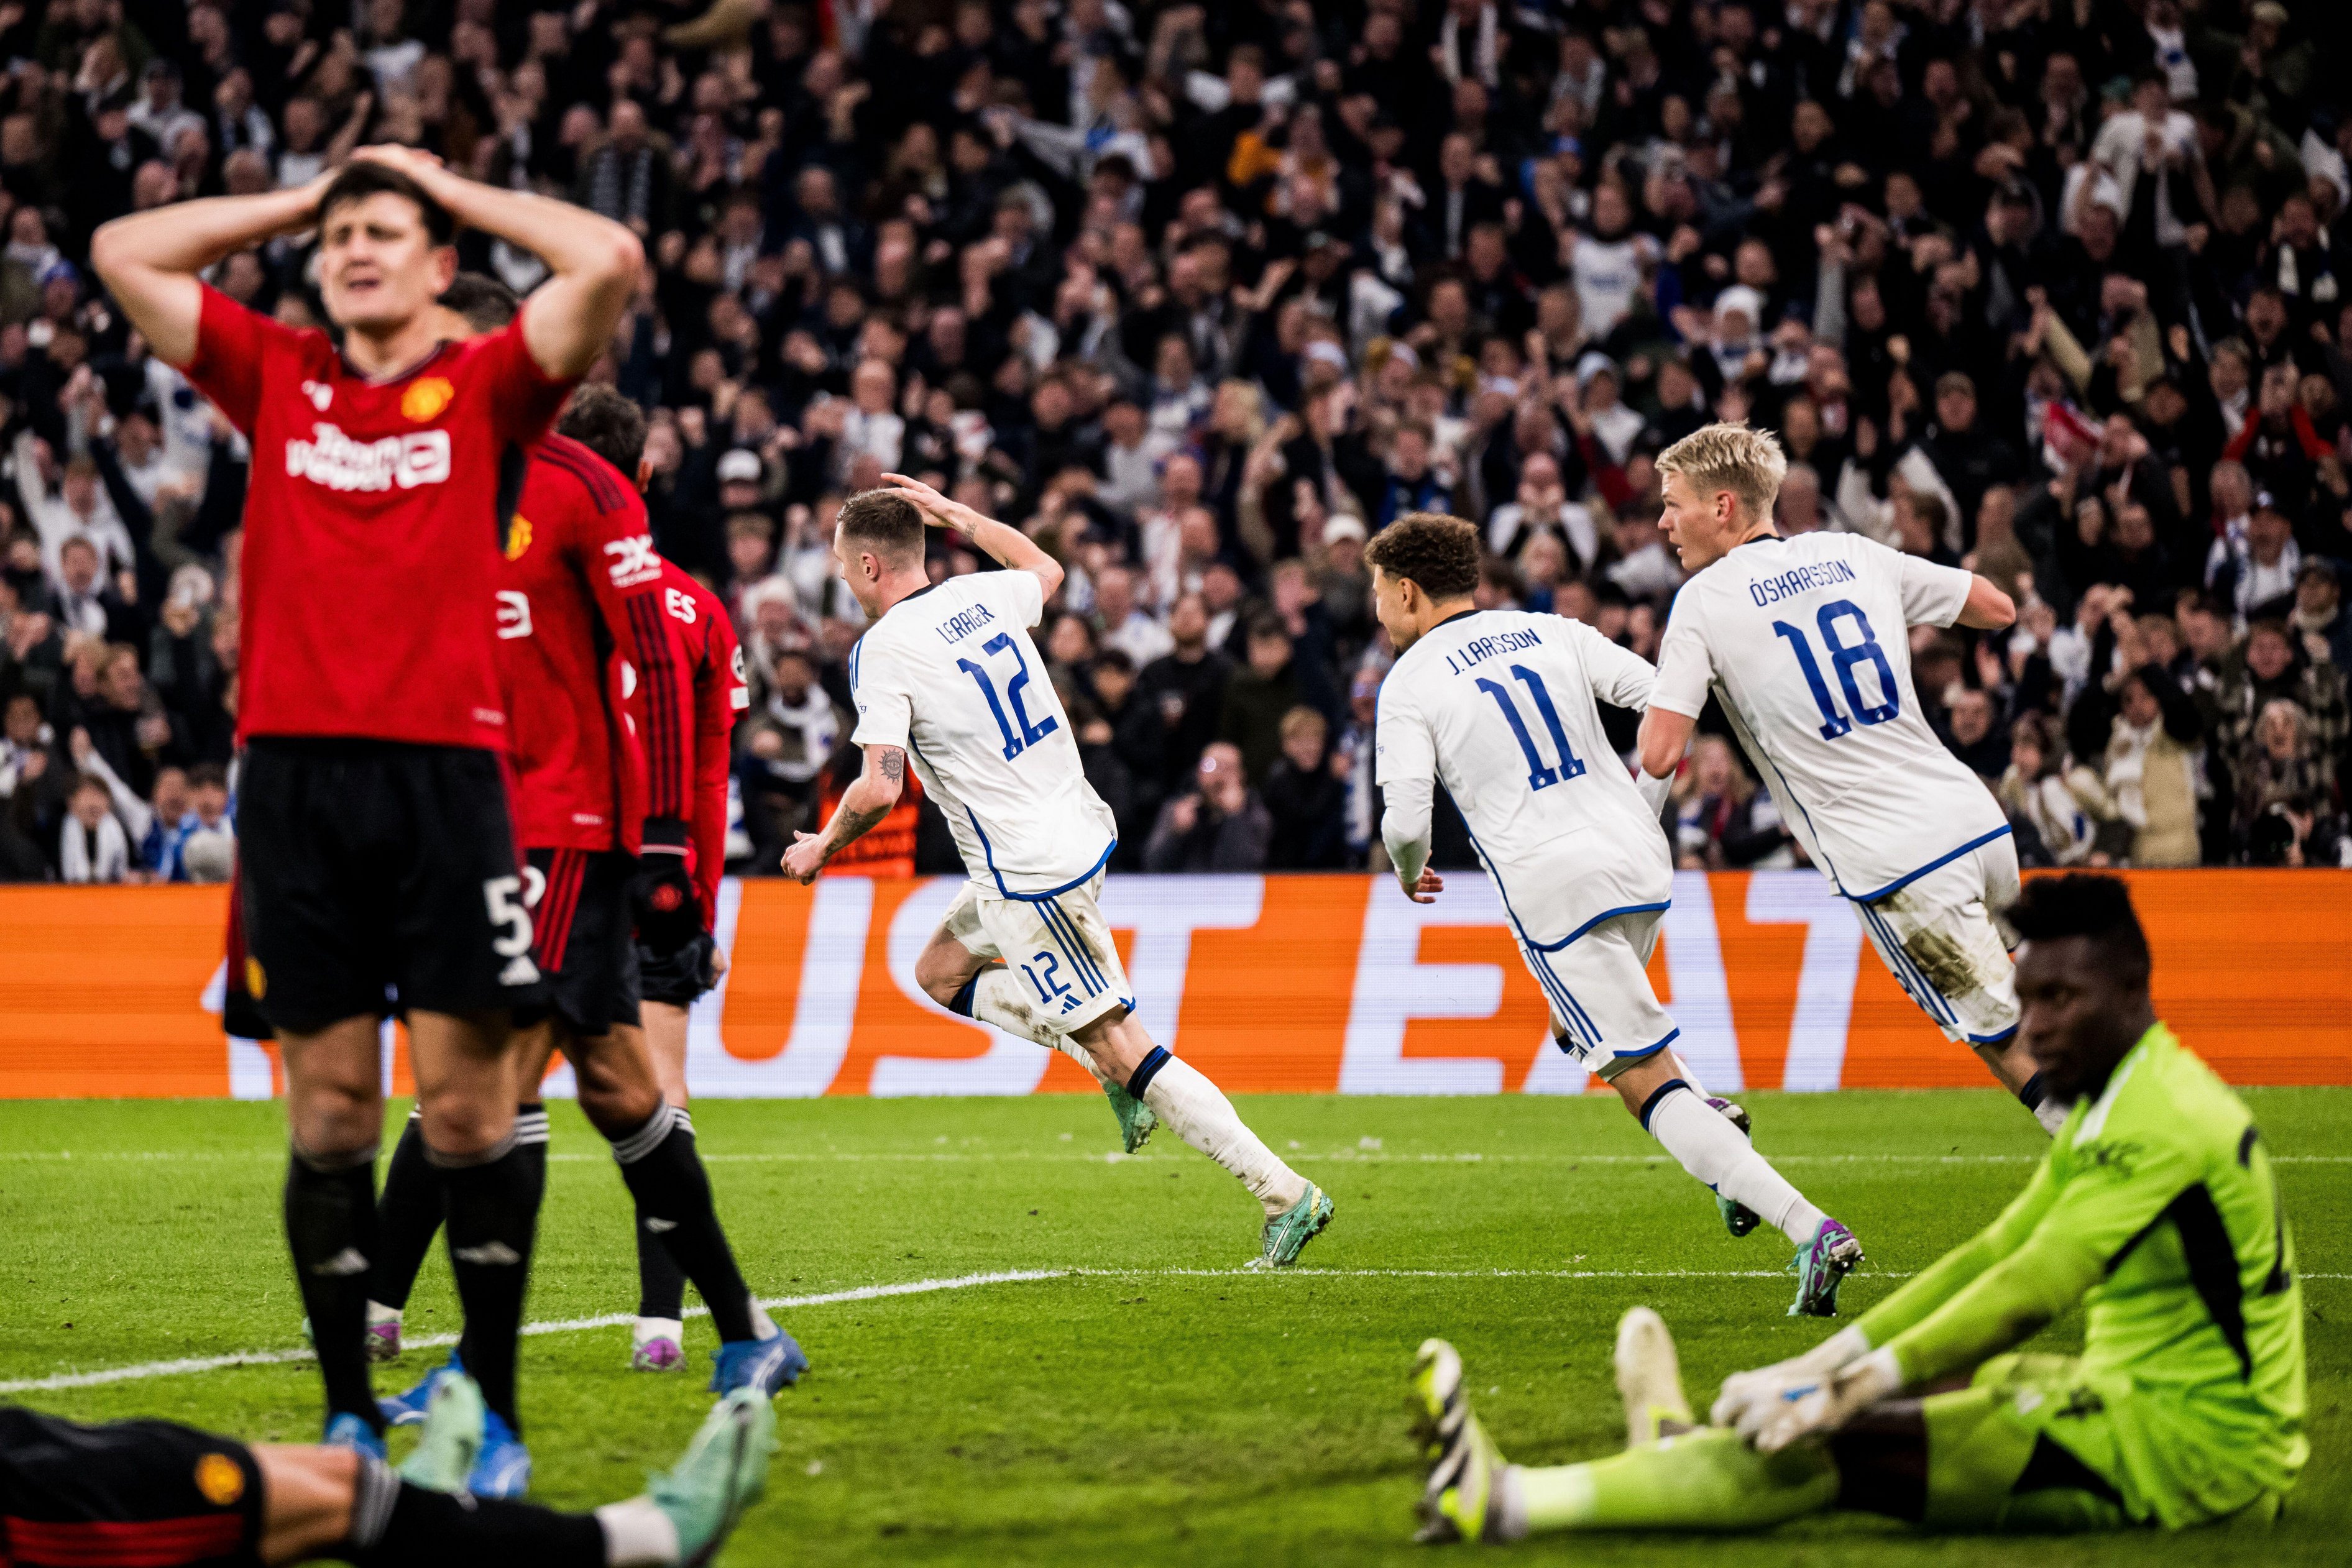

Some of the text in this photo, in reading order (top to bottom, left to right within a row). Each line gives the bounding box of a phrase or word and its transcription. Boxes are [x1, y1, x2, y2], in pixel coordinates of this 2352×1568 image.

[935, 603, 995, 644] LERAGER
[1749, 559, 1855, 607] ÓSKARSSON
[956, 632, 1059, 762] 12
[1772, 599, 1900, 741] 18
[1475, 664, 1587, 792] 11
[483, 876, 533, 957] 5
[538, 874, 1265, 1099] UST
[1020, 951, 1072, 1005] 12
